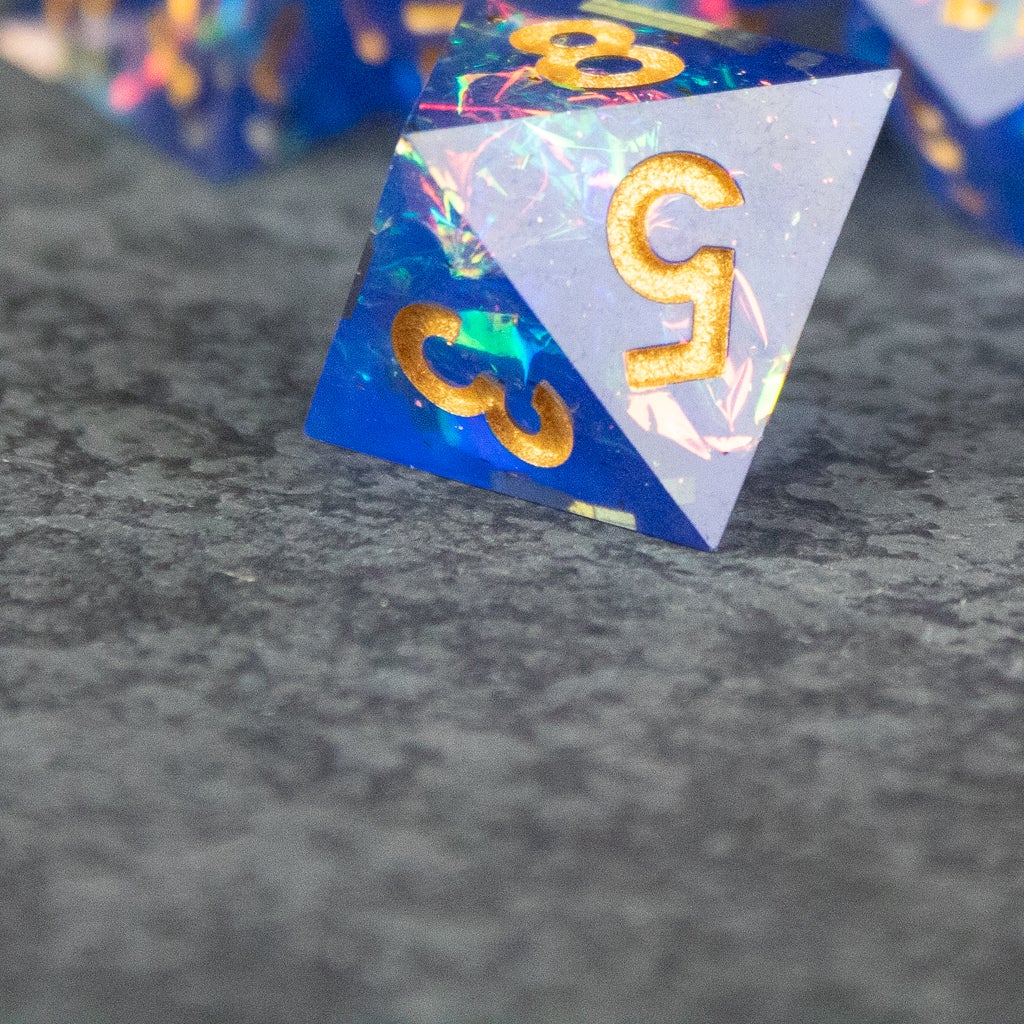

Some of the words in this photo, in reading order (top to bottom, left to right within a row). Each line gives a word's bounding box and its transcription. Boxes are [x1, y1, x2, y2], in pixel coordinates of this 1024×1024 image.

[508, 19, 686, 90] 8
[605, 150, 745, 391] 5
[391, 303, 575, 469] 3
